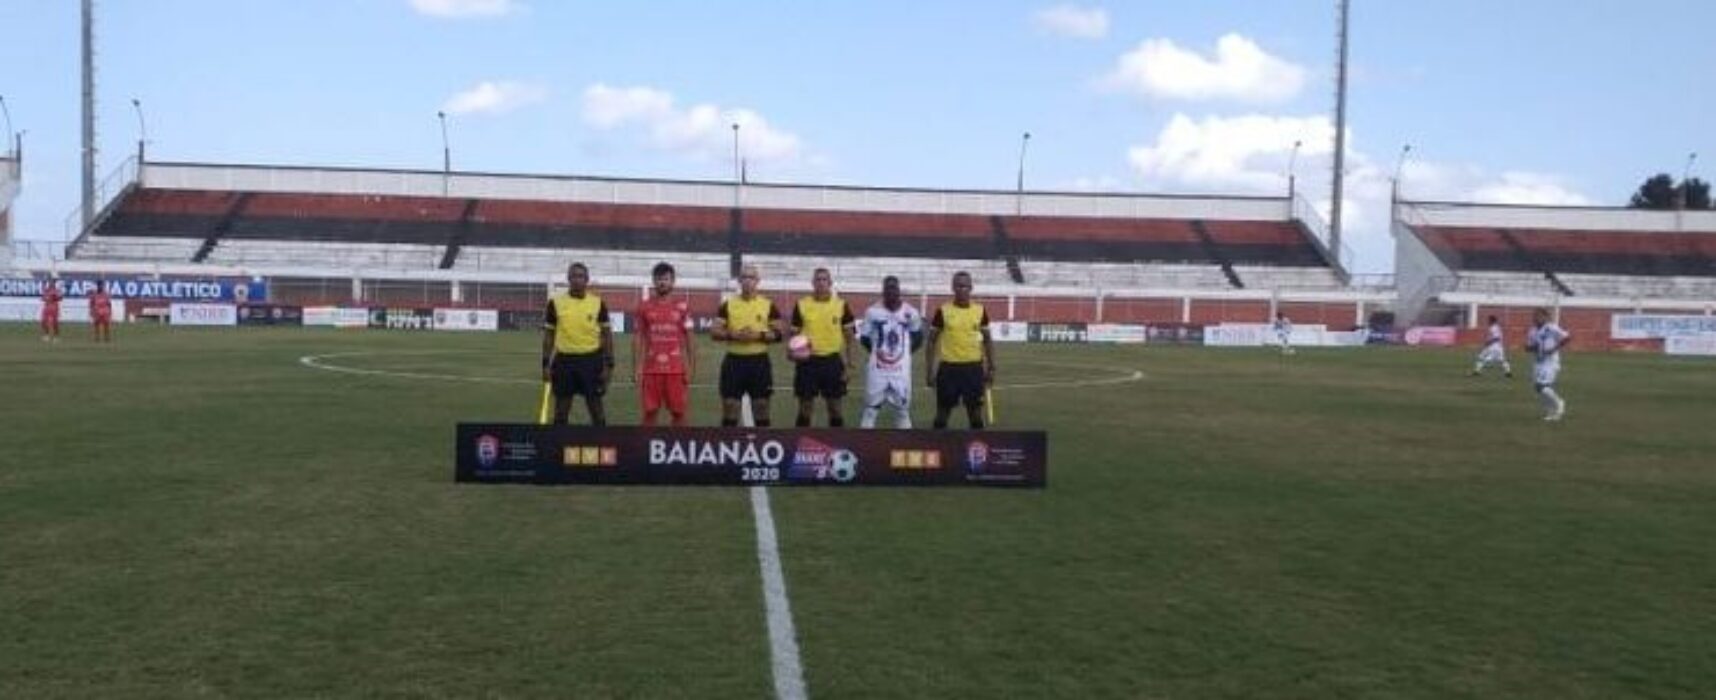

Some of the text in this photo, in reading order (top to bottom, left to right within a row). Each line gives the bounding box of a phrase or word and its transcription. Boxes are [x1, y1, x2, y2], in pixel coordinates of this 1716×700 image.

[69, 280, 122, 297] APIA
[125, 281, 138, 297] O
[649, 434, 784, 465] BAIANÃO
[741, 467, 780, 481] 2020
